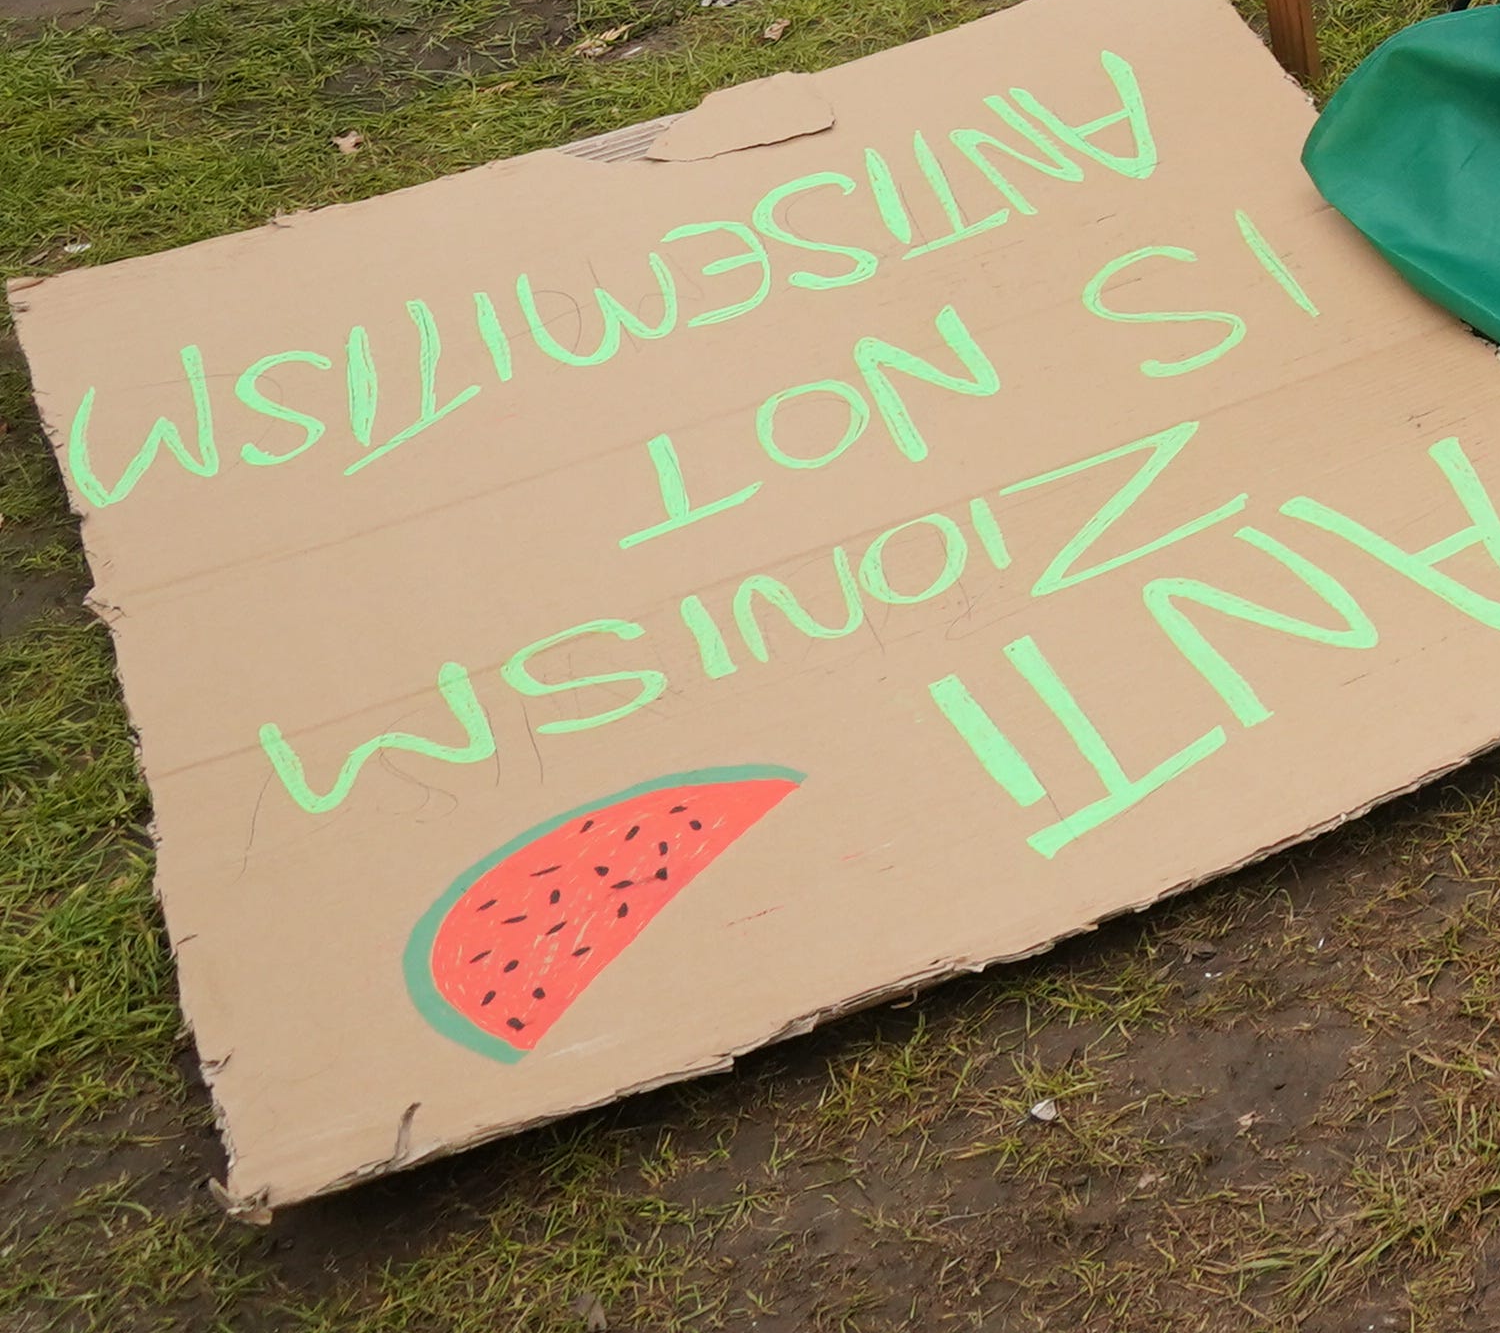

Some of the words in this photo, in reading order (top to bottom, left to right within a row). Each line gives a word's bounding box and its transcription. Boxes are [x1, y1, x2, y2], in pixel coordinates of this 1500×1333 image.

[66, 49, 1160, 510] ANTISEMITISM
[618, 302, 1002, 550] NOT
[1083, 206, 1322, 380] IS
[259, 420, 1250, 817] ZIONISM
